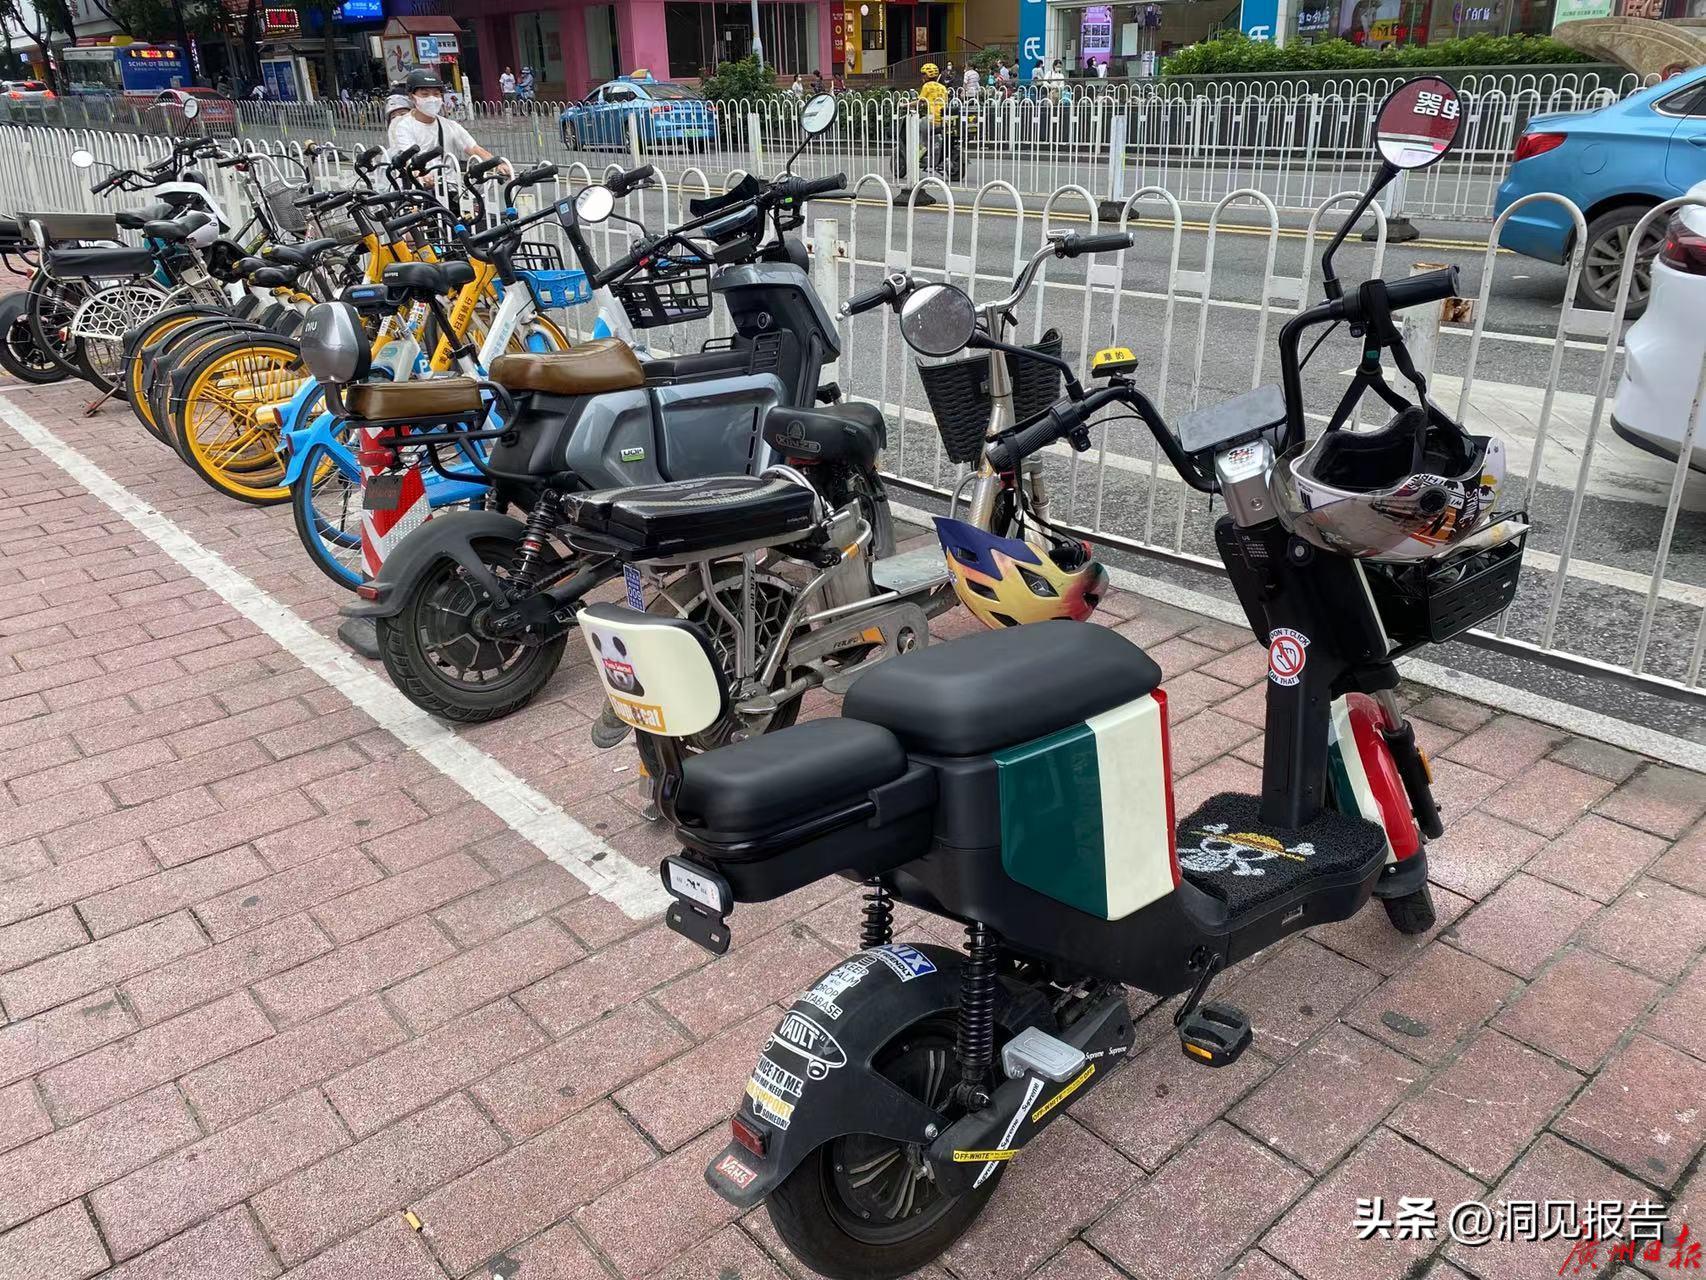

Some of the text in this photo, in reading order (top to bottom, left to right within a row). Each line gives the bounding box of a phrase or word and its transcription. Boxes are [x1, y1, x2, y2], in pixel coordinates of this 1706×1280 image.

[1290, 630, 1310, 646] CLICK
[1270, 670, 1279, 682] ON
[815, 984, 839, 999] DROP
[772, 1067, 785, 1084] TO
[762, 1109, 789, 1129] SOMEDAY
